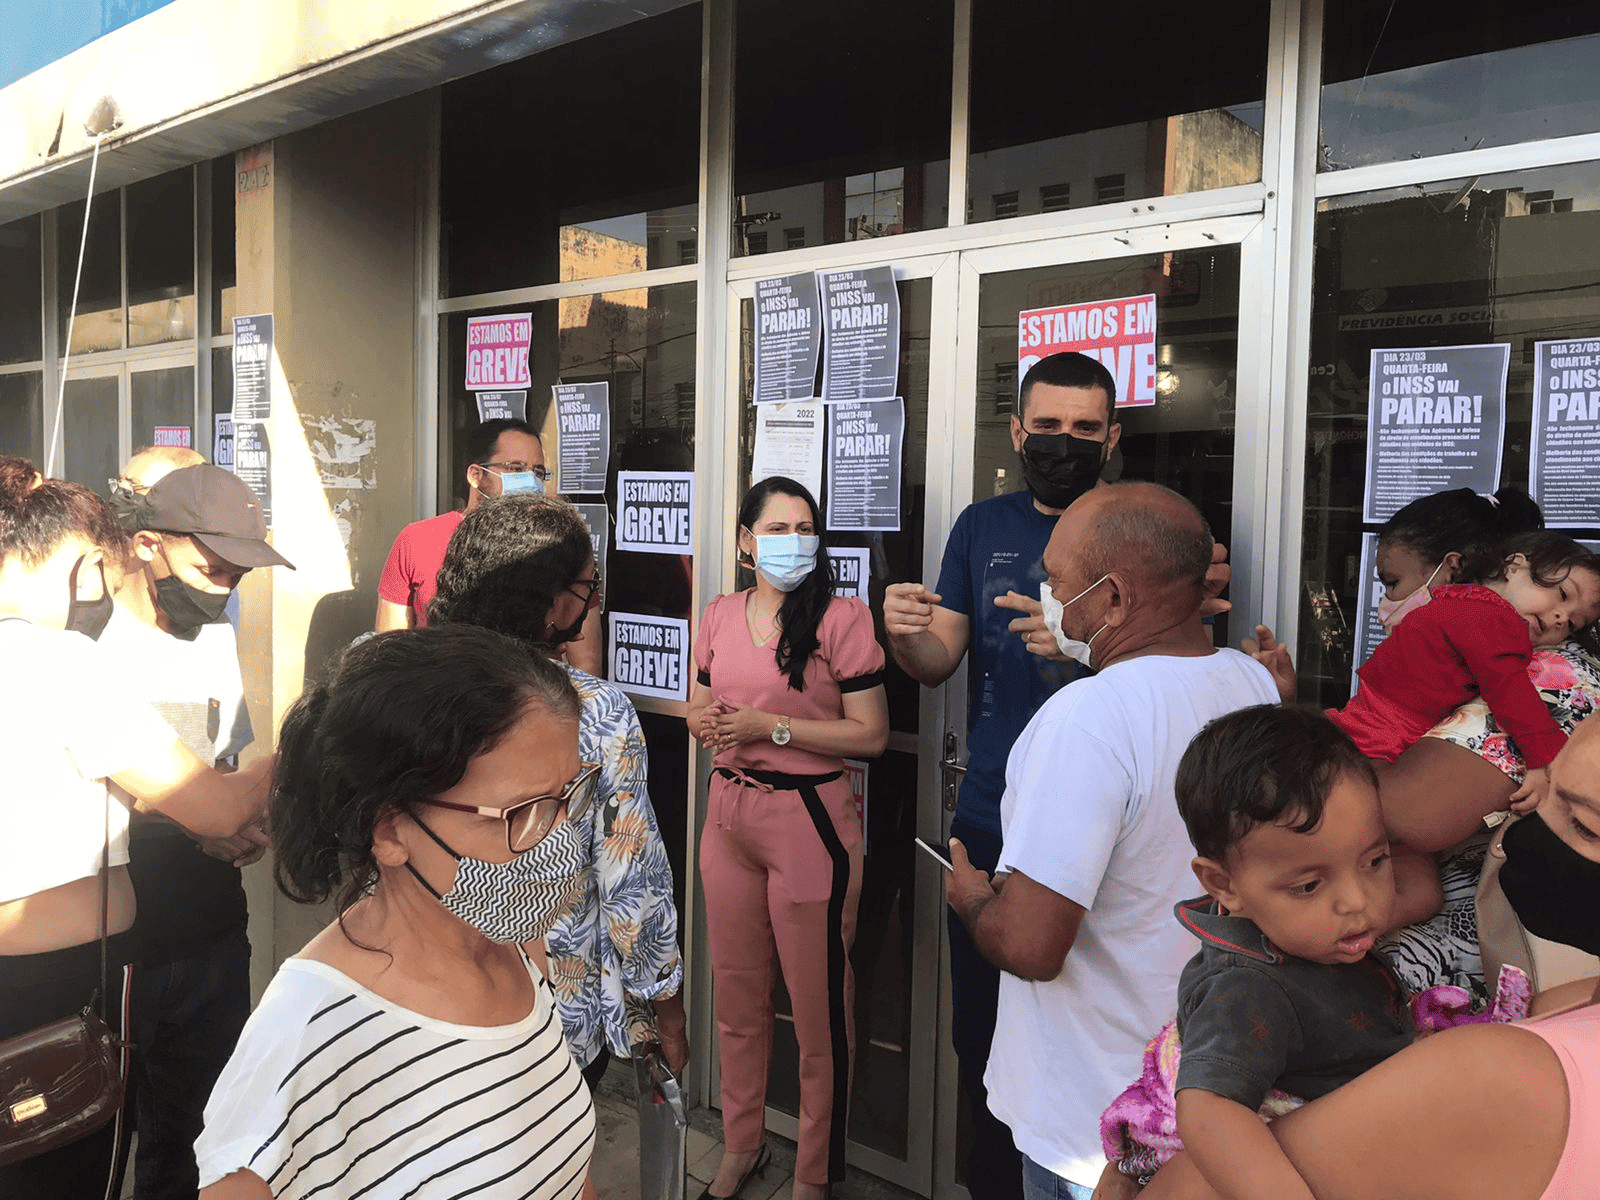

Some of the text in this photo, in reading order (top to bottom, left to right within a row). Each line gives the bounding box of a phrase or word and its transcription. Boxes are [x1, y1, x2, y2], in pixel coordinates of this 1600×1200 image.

[829, 280, 867, 292] QUARTA-FEIRA
[766, 296, 787, 311] INSS
[788, 297, 798, 308] VAI
[836, 290, 861, 306] INSS
[862, 292, 875, 303] VAI
[762, 307, 810, 334] PARAR!
[832, 303, 888, 330] PARAR!
[1019, 300, 1155, 348] ESTAMOS EM
[1341, 313, 1443, 329] PREVIDÊNCIA
[469, 322, 528, 344] ESTAMOS EM
[1384, 352, 1426, 362] DIA 23/03
[1551, 342, 1600, 354] DIA 23/03
[469, 347, 528, 382] GREVE
[1383, 363, 1448, 375] QUARTA-FEIRA
[1393, 376, 1435, 394] INSS
[1437, 380, 1459, 393] VAI
[1562, 369, 1600, 389] INS
[796, 410, 814, 418] 2022
[1381, 395, 1482, 424] PARAR!
[561, 413, 601, 432] PARAR!
[842, 420, 864, 434] INSS
[866, 423, 878, 433] VAI
[836, 434, 890, 457] PARAR!
[624, 482, 688, 503] ESTAMOS EM
[624, 506, 688, 543] GREVE
[840, 560, 858, 581] EM
[616, 623, 679, 649] ESTAMOS EM
[615, 647, 679, 689] GREVE
